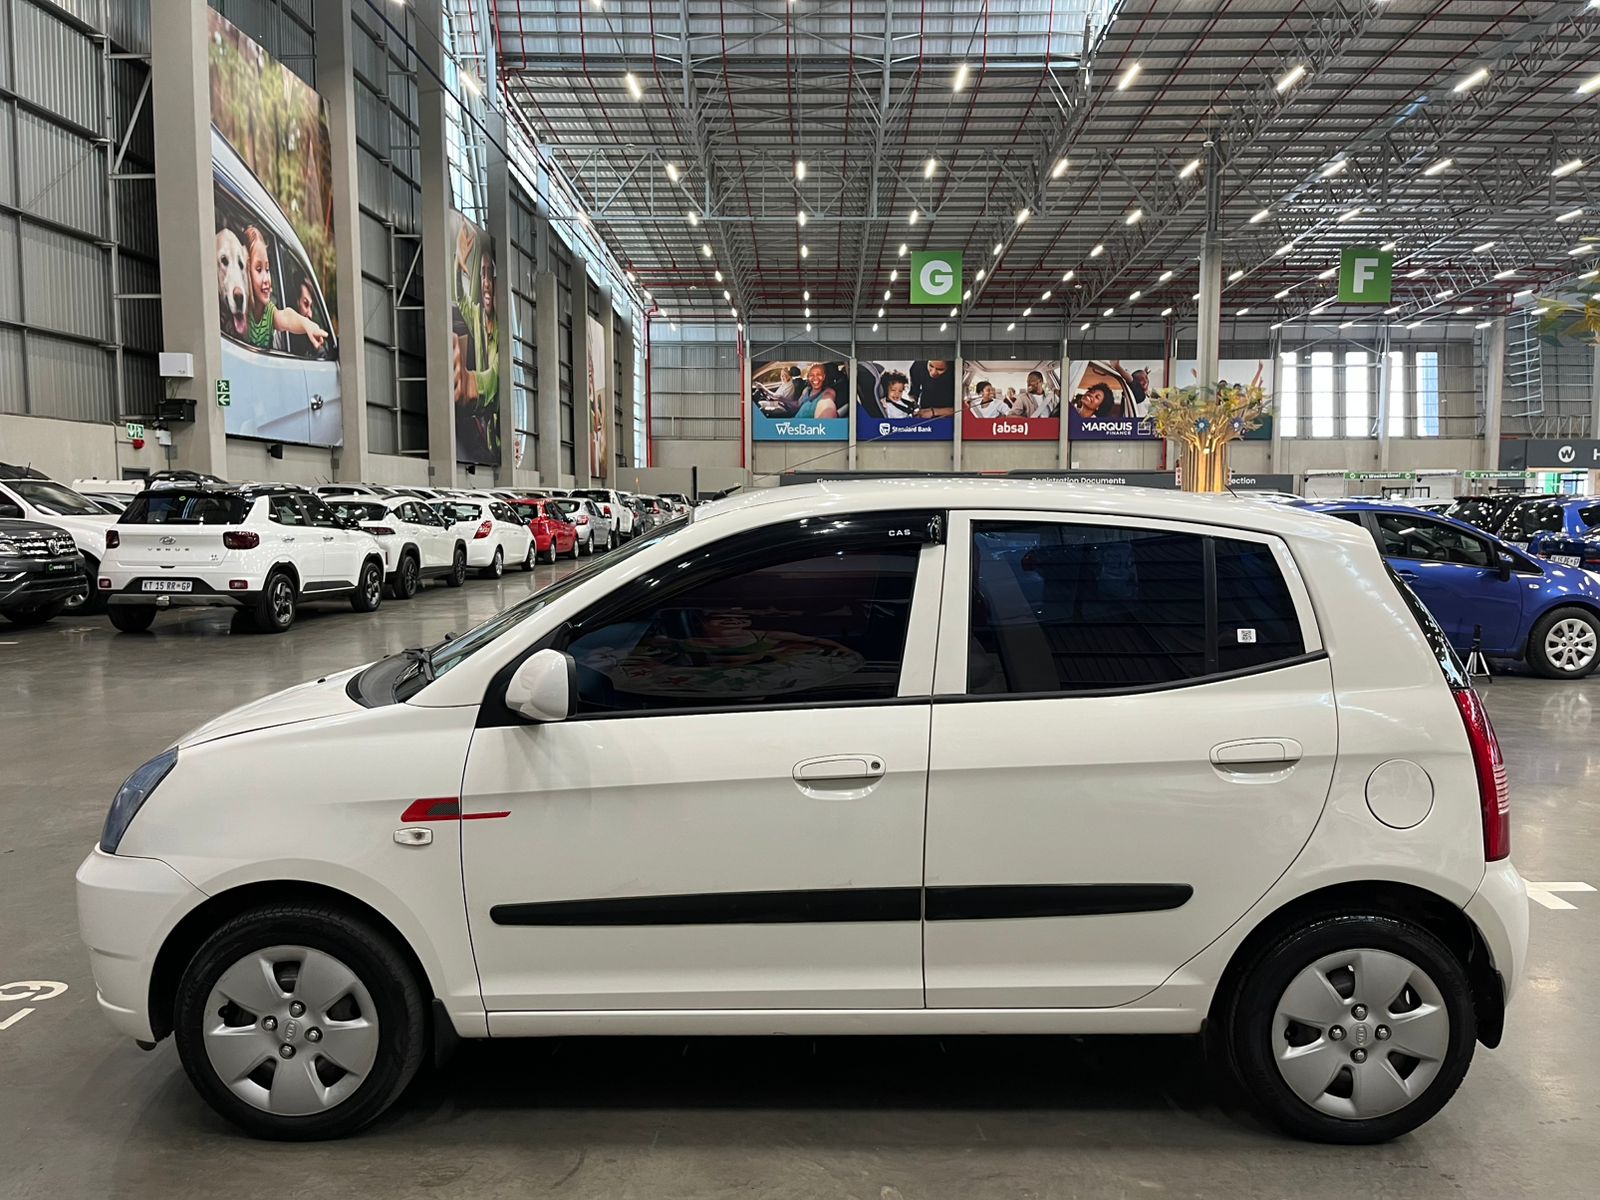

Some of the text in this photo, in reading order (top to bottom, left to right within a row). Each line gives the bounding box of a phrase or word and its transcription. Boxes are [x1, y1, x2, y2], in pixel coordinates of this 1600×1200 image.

[919, 260, 953, 296] G
[1352, 257, 1379, 294] F
[775, 421, 826, 436] WesBank
[918, 425, 933, 433] Bank
[992, 422, 1029, 436] (absa)
[1081, 422, 1133, 431] MARQUIS
[1080, 477, 1126, 485] Documents
[1231, 476, 1256, 485] ection
[888, 529, 911, 537] CAS
[155, 581, 164, 590] 15
[181, 582, 191, 591] GP
